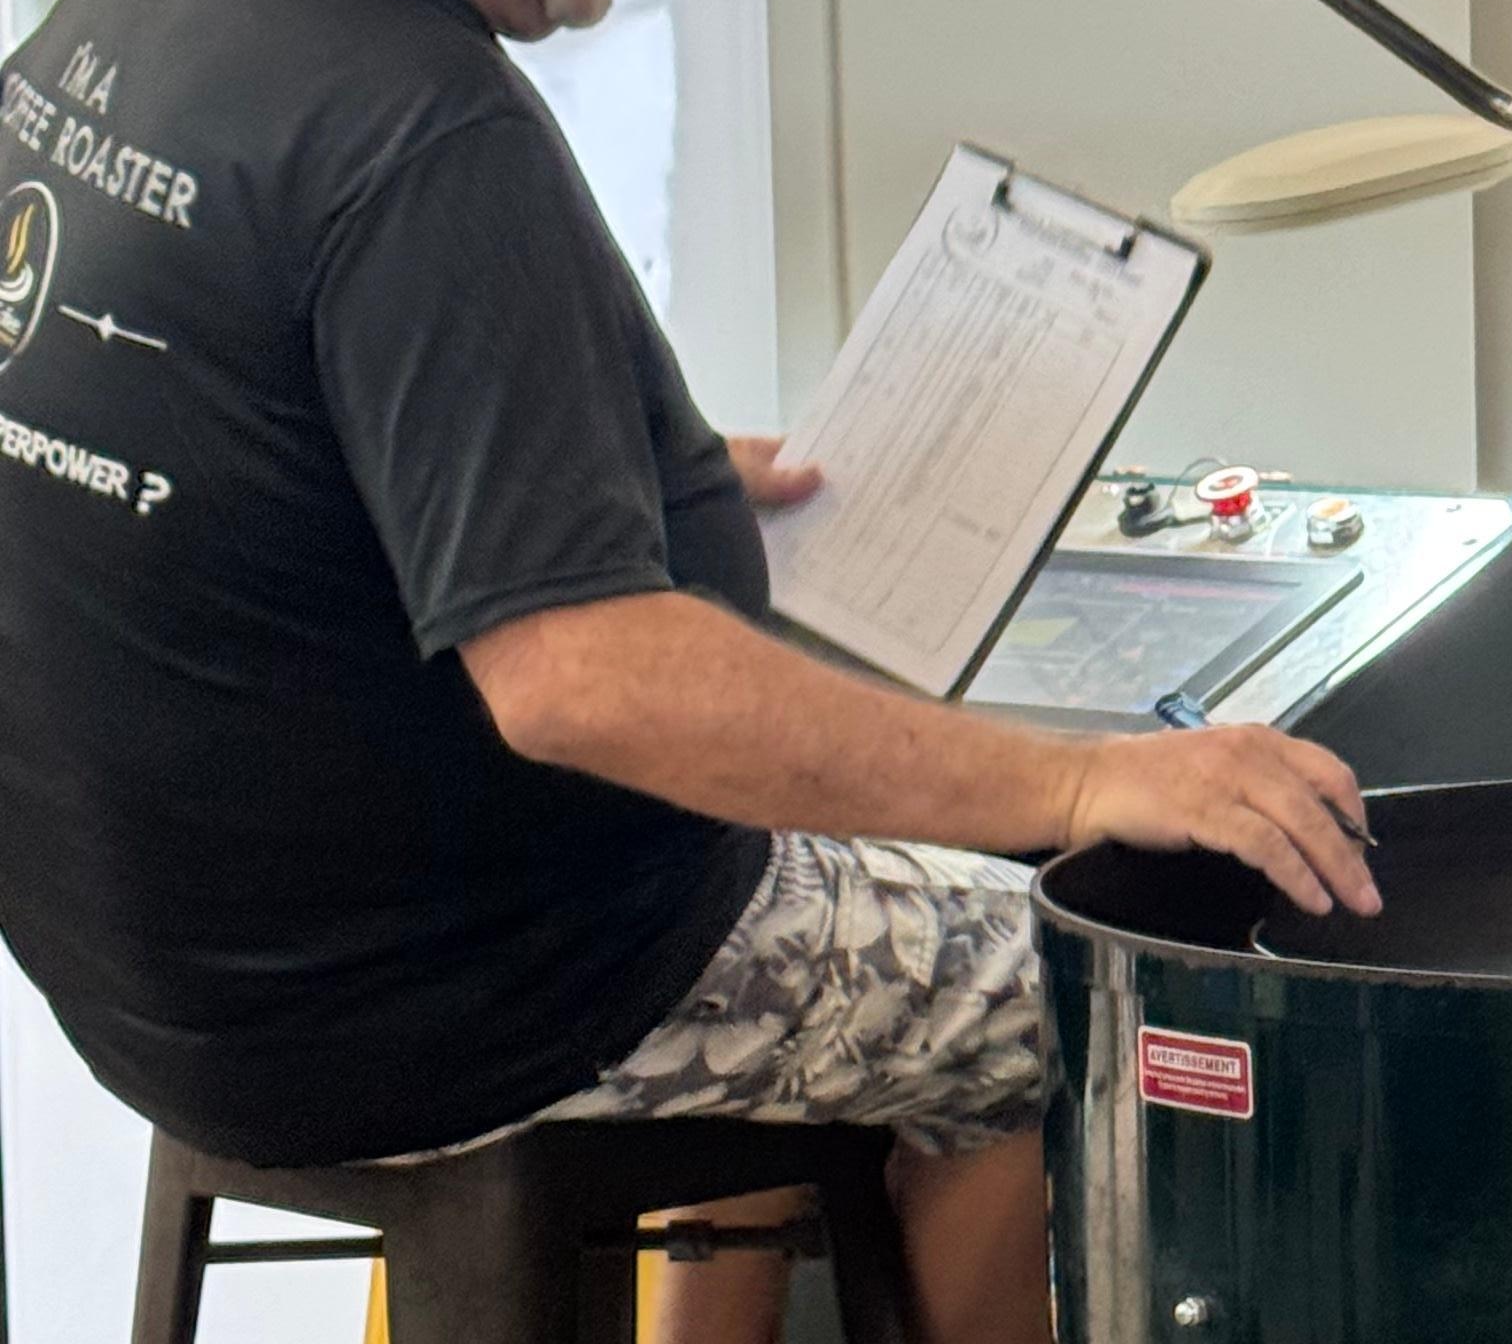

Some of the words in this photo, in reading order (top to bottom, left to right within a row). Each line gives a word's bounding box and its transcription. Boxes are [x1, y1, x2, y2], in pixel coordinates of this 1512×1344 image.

[85, 61, 117, 115] A
[50, 115, 198, 230] ROASTER
[1149, 1049, 1237, 1075] AVERTISSEMENT
